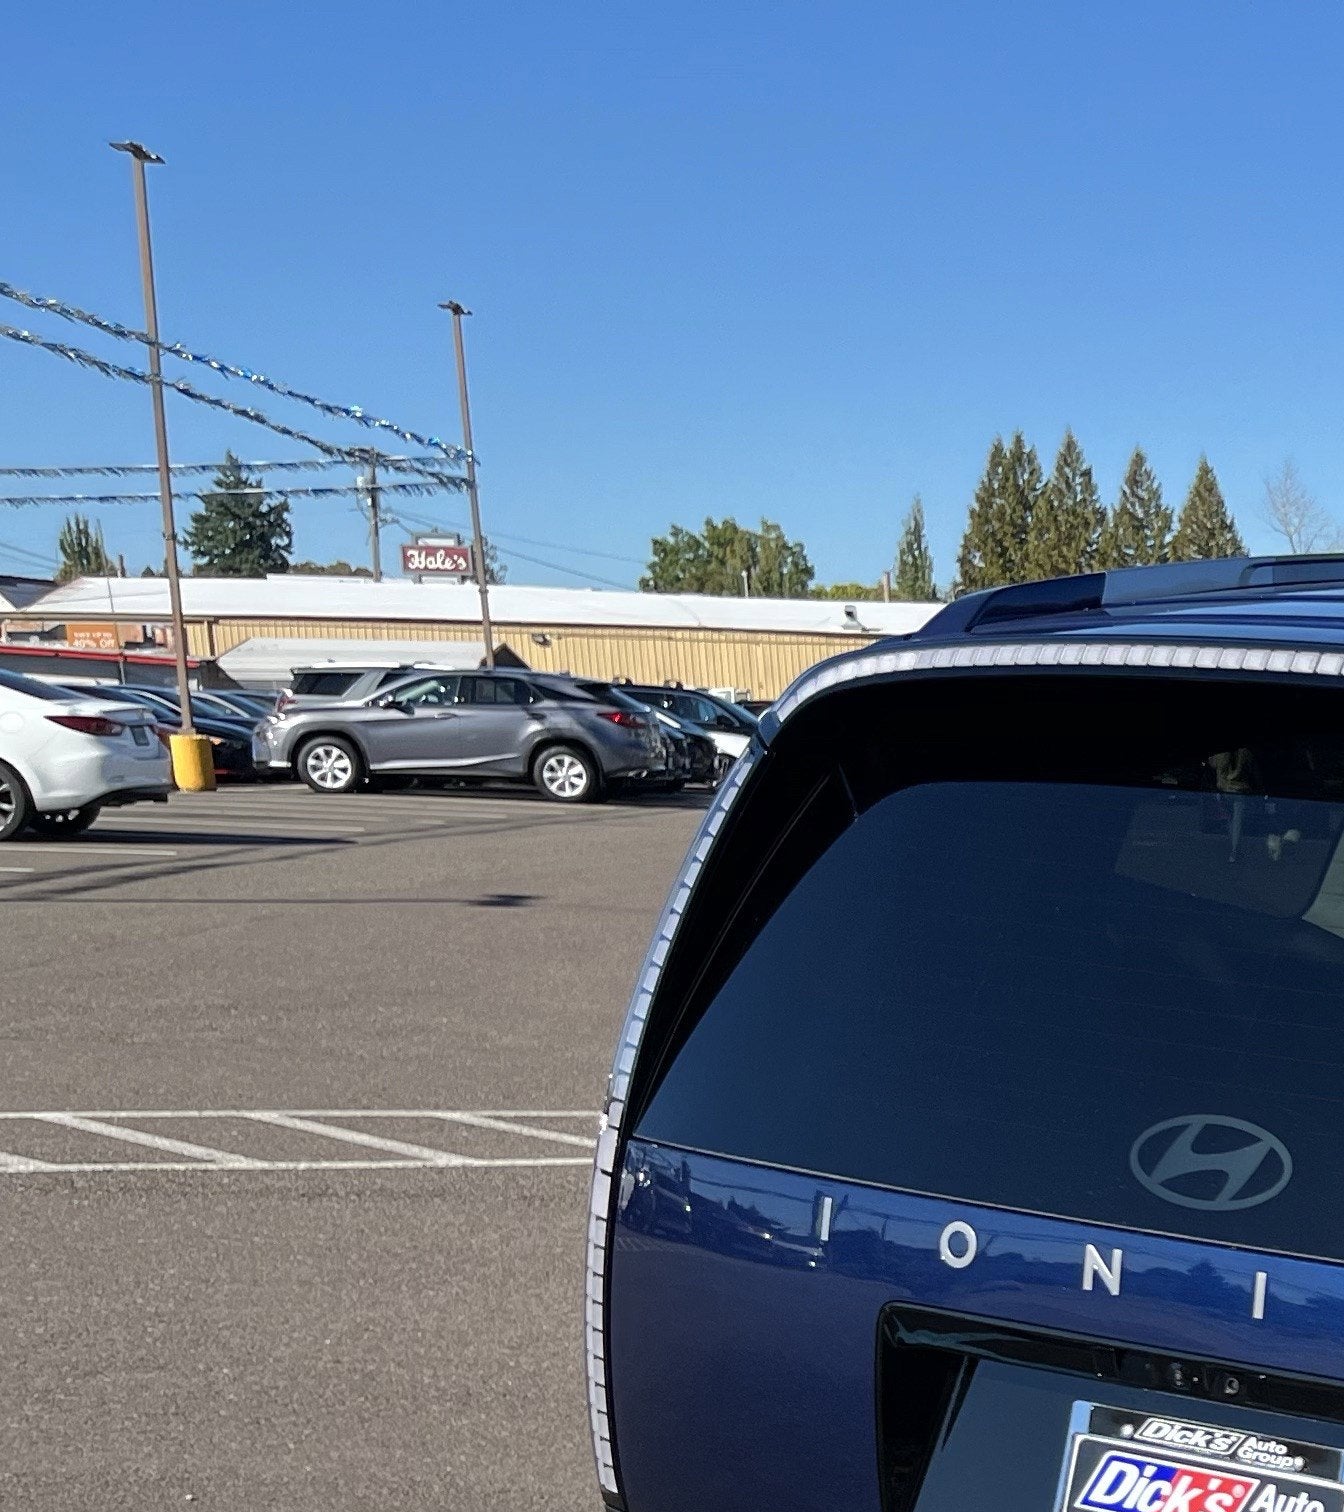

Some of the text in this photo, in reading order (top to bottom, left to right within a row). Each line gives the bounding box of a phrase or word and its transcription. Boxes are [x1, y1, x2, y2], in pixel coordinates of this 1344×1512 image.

[406, 548, 468, 571] Hale's
[1143, 1421, 1235, 1451] Dick's
[1242, 1436, 1288, 1455] Auto
[1237, 1446, 1295, 1467] Group
